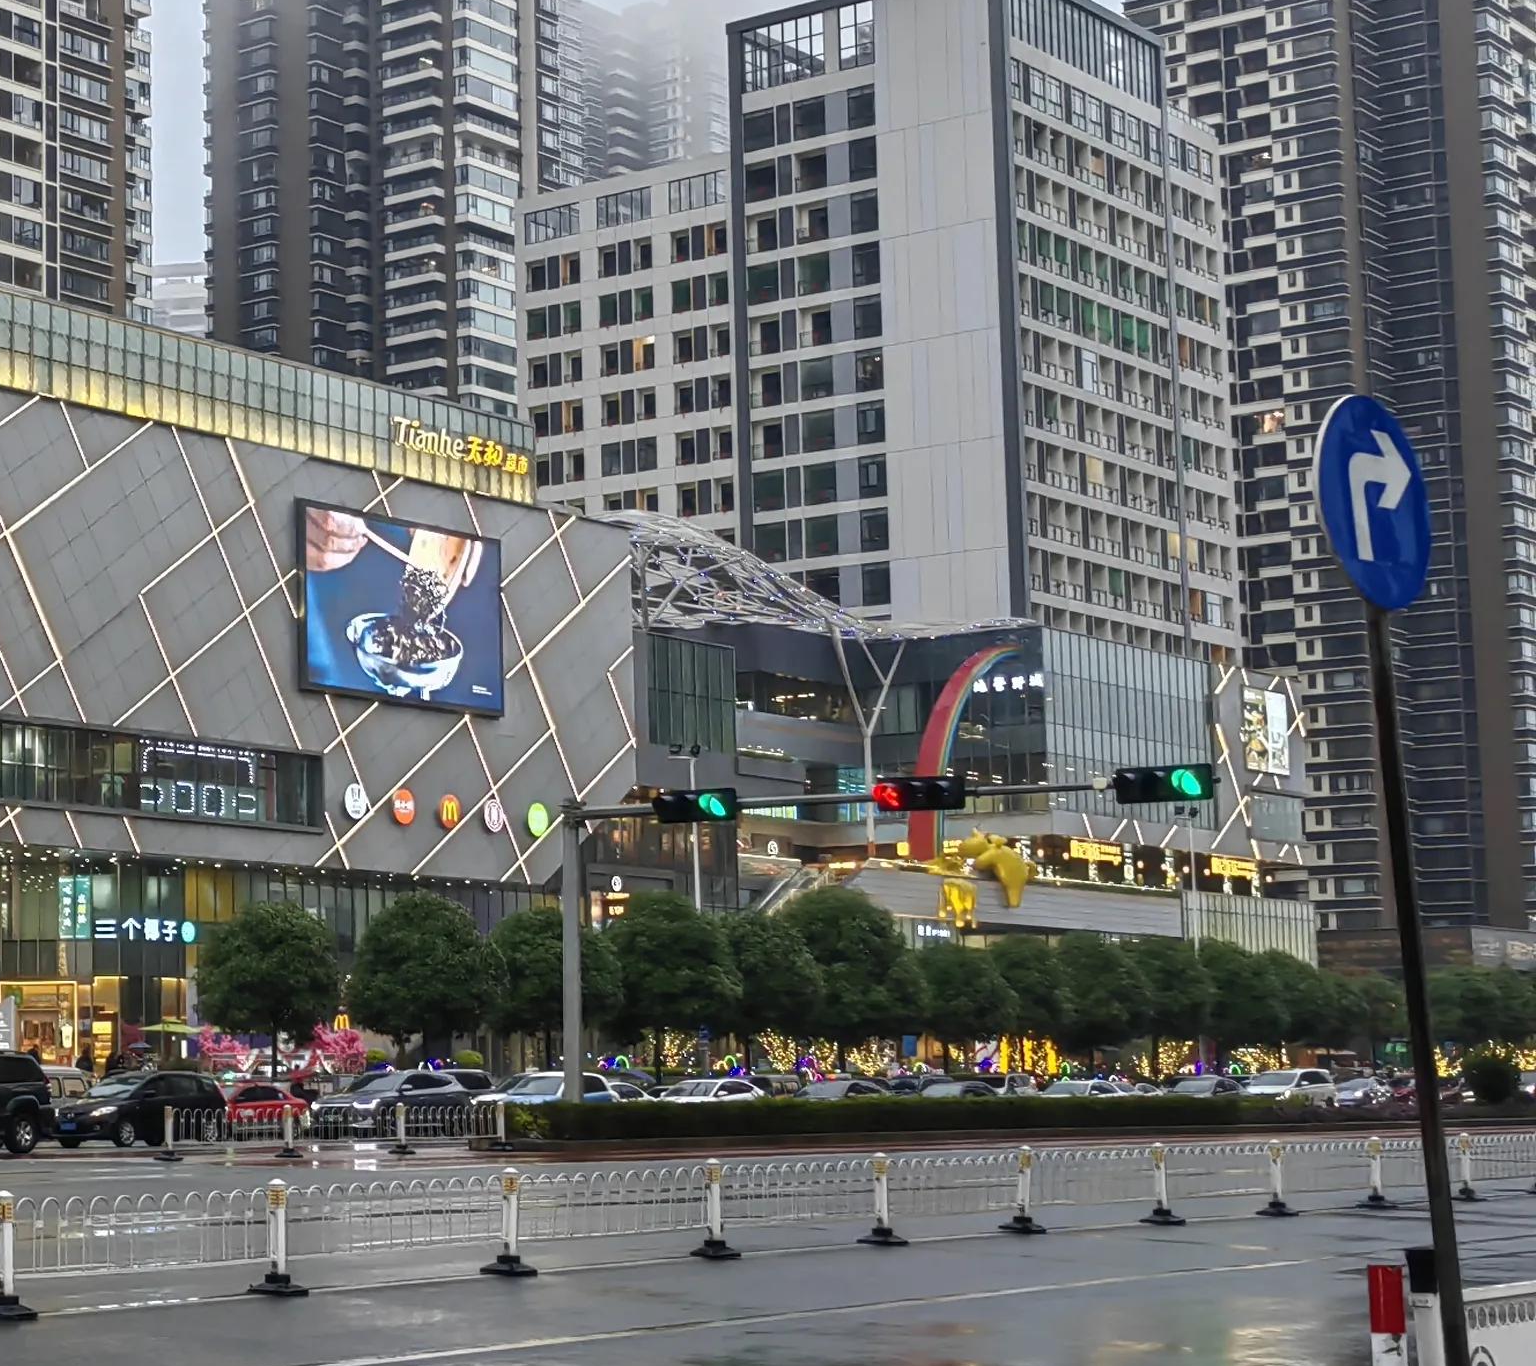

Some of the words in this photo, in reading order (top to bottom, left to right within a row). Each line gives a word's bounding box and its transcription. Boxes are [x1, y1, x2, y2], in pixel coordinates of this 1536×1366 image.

[389, 415, 465, 460] Tianhe
[94, 917, 178, 942] 三个椰子
